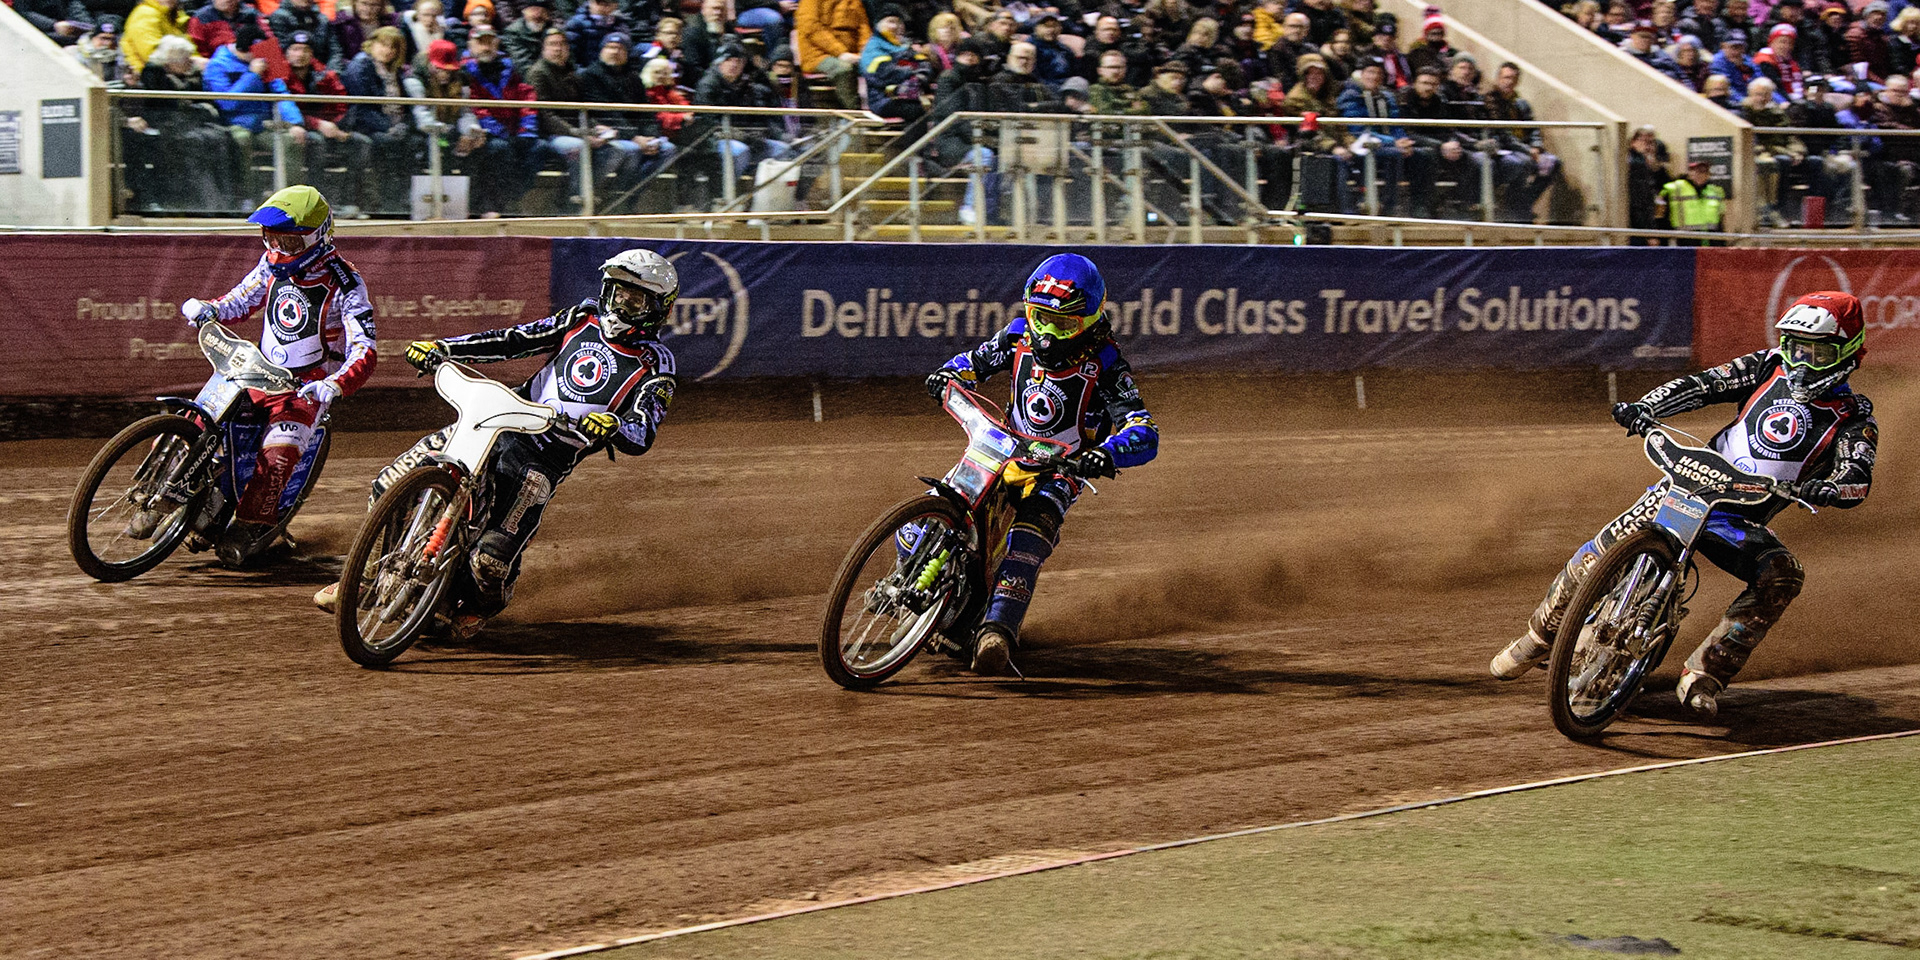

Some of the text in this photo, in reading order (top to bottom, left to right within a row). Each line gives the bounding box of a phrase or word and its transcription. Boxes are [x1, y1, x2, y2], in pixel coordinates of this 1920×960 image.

[330, 262, 350, 285] Joma
[76, 297, 177, 320] Proud to
[375, 294, 526, 322] Vue Speedway
[1103, 287, 1183, 336] orld
[1194, 287, 1307, 335] Class
[1319, 286, 1447, 333] Travel
[1457, 285, 1641, 332] Solutions
[271, 323, 300, 341] MEMORIAL
[576, 350, 594, 359] BELLE
[595, 351, 605, 362] VUE
[580, 341, 618, 374] PETER CRAVEN
[1079, 361, 1099, 378] 12
[557, 376, 586, 402] MEMORIAL
[1767, 406, 1787, 415] BELLE
[1789, 408, 1800, 417] VUE
[1748, 433, 1781, 459] MEMORIAL
[378, 441, 427, 489] HANSEN
[431, 434, 445, 449] &
[1679, 455, 1732, 482] HAGON
[1673, 463, 1727, 494] SHOCKS
[1610, 486, 1668, 536] HAGON
